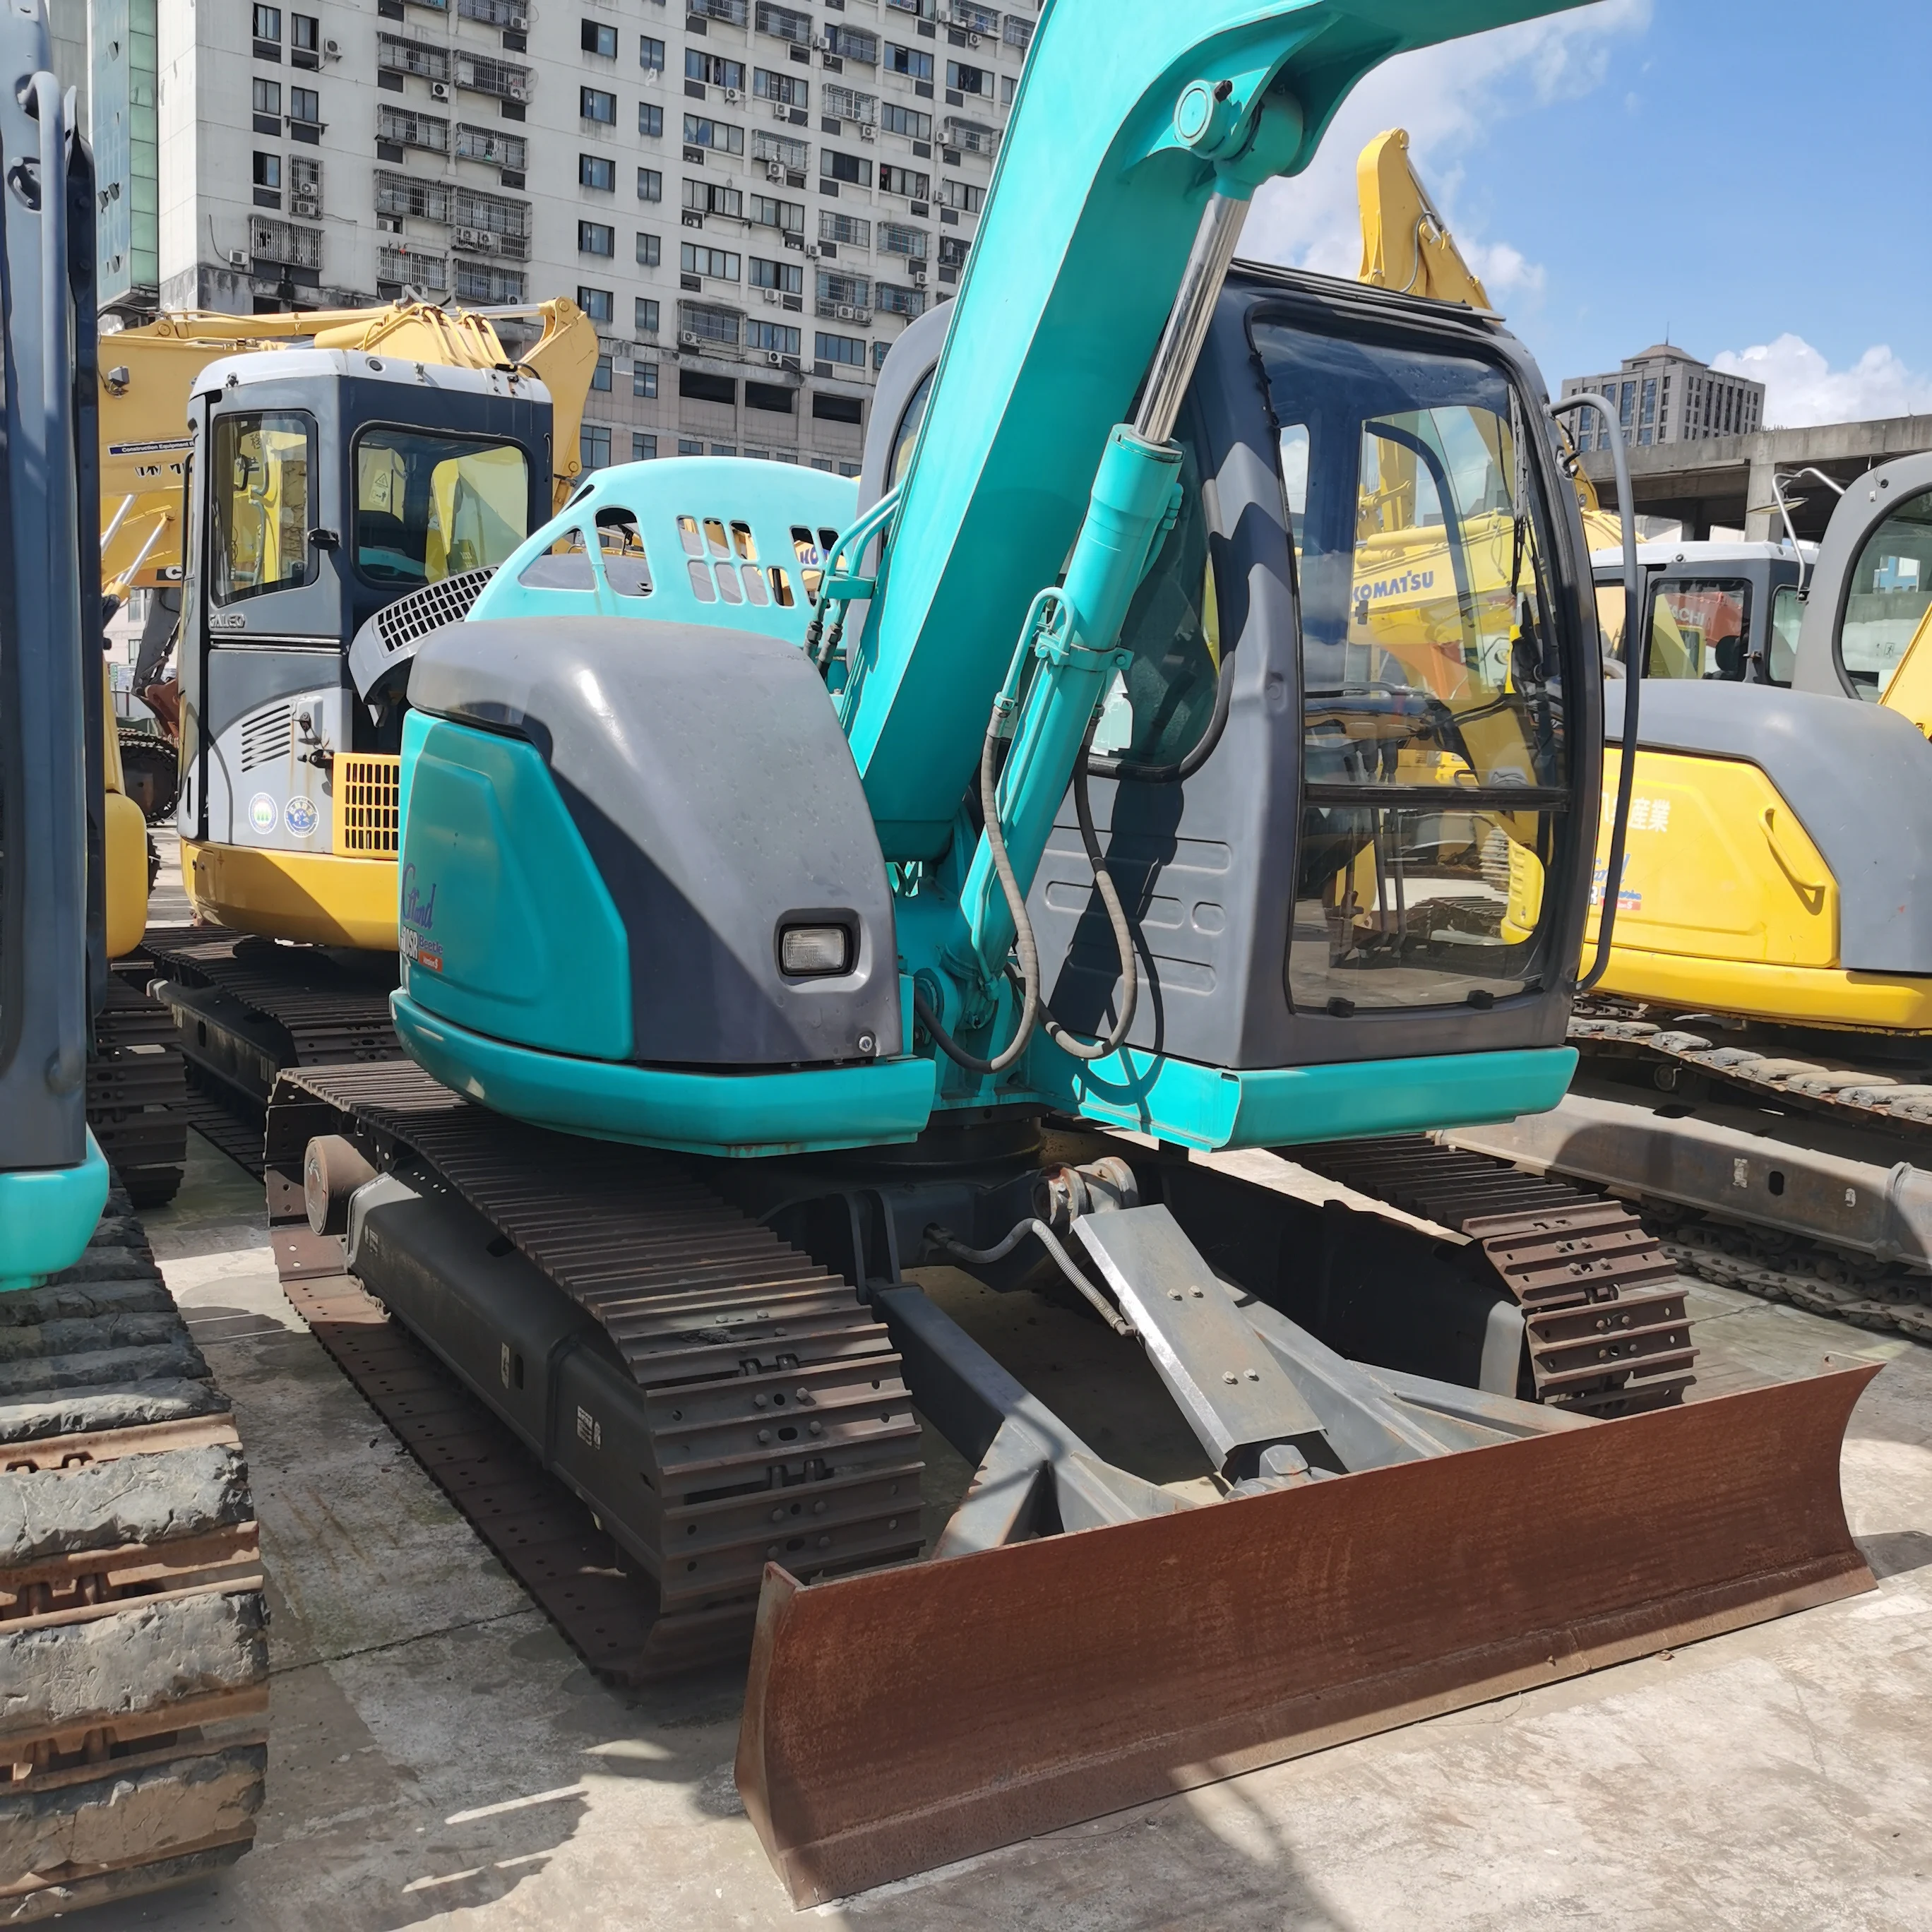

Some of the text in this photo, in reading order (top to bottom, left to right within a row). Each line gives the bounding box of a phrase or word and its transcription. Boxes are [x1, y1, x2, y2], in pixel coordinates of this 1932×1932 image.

[121, 444, 159, 453] Construction
[159, 441, 189, 450] Equipment
[419, 934, 443, 955] Beetle
